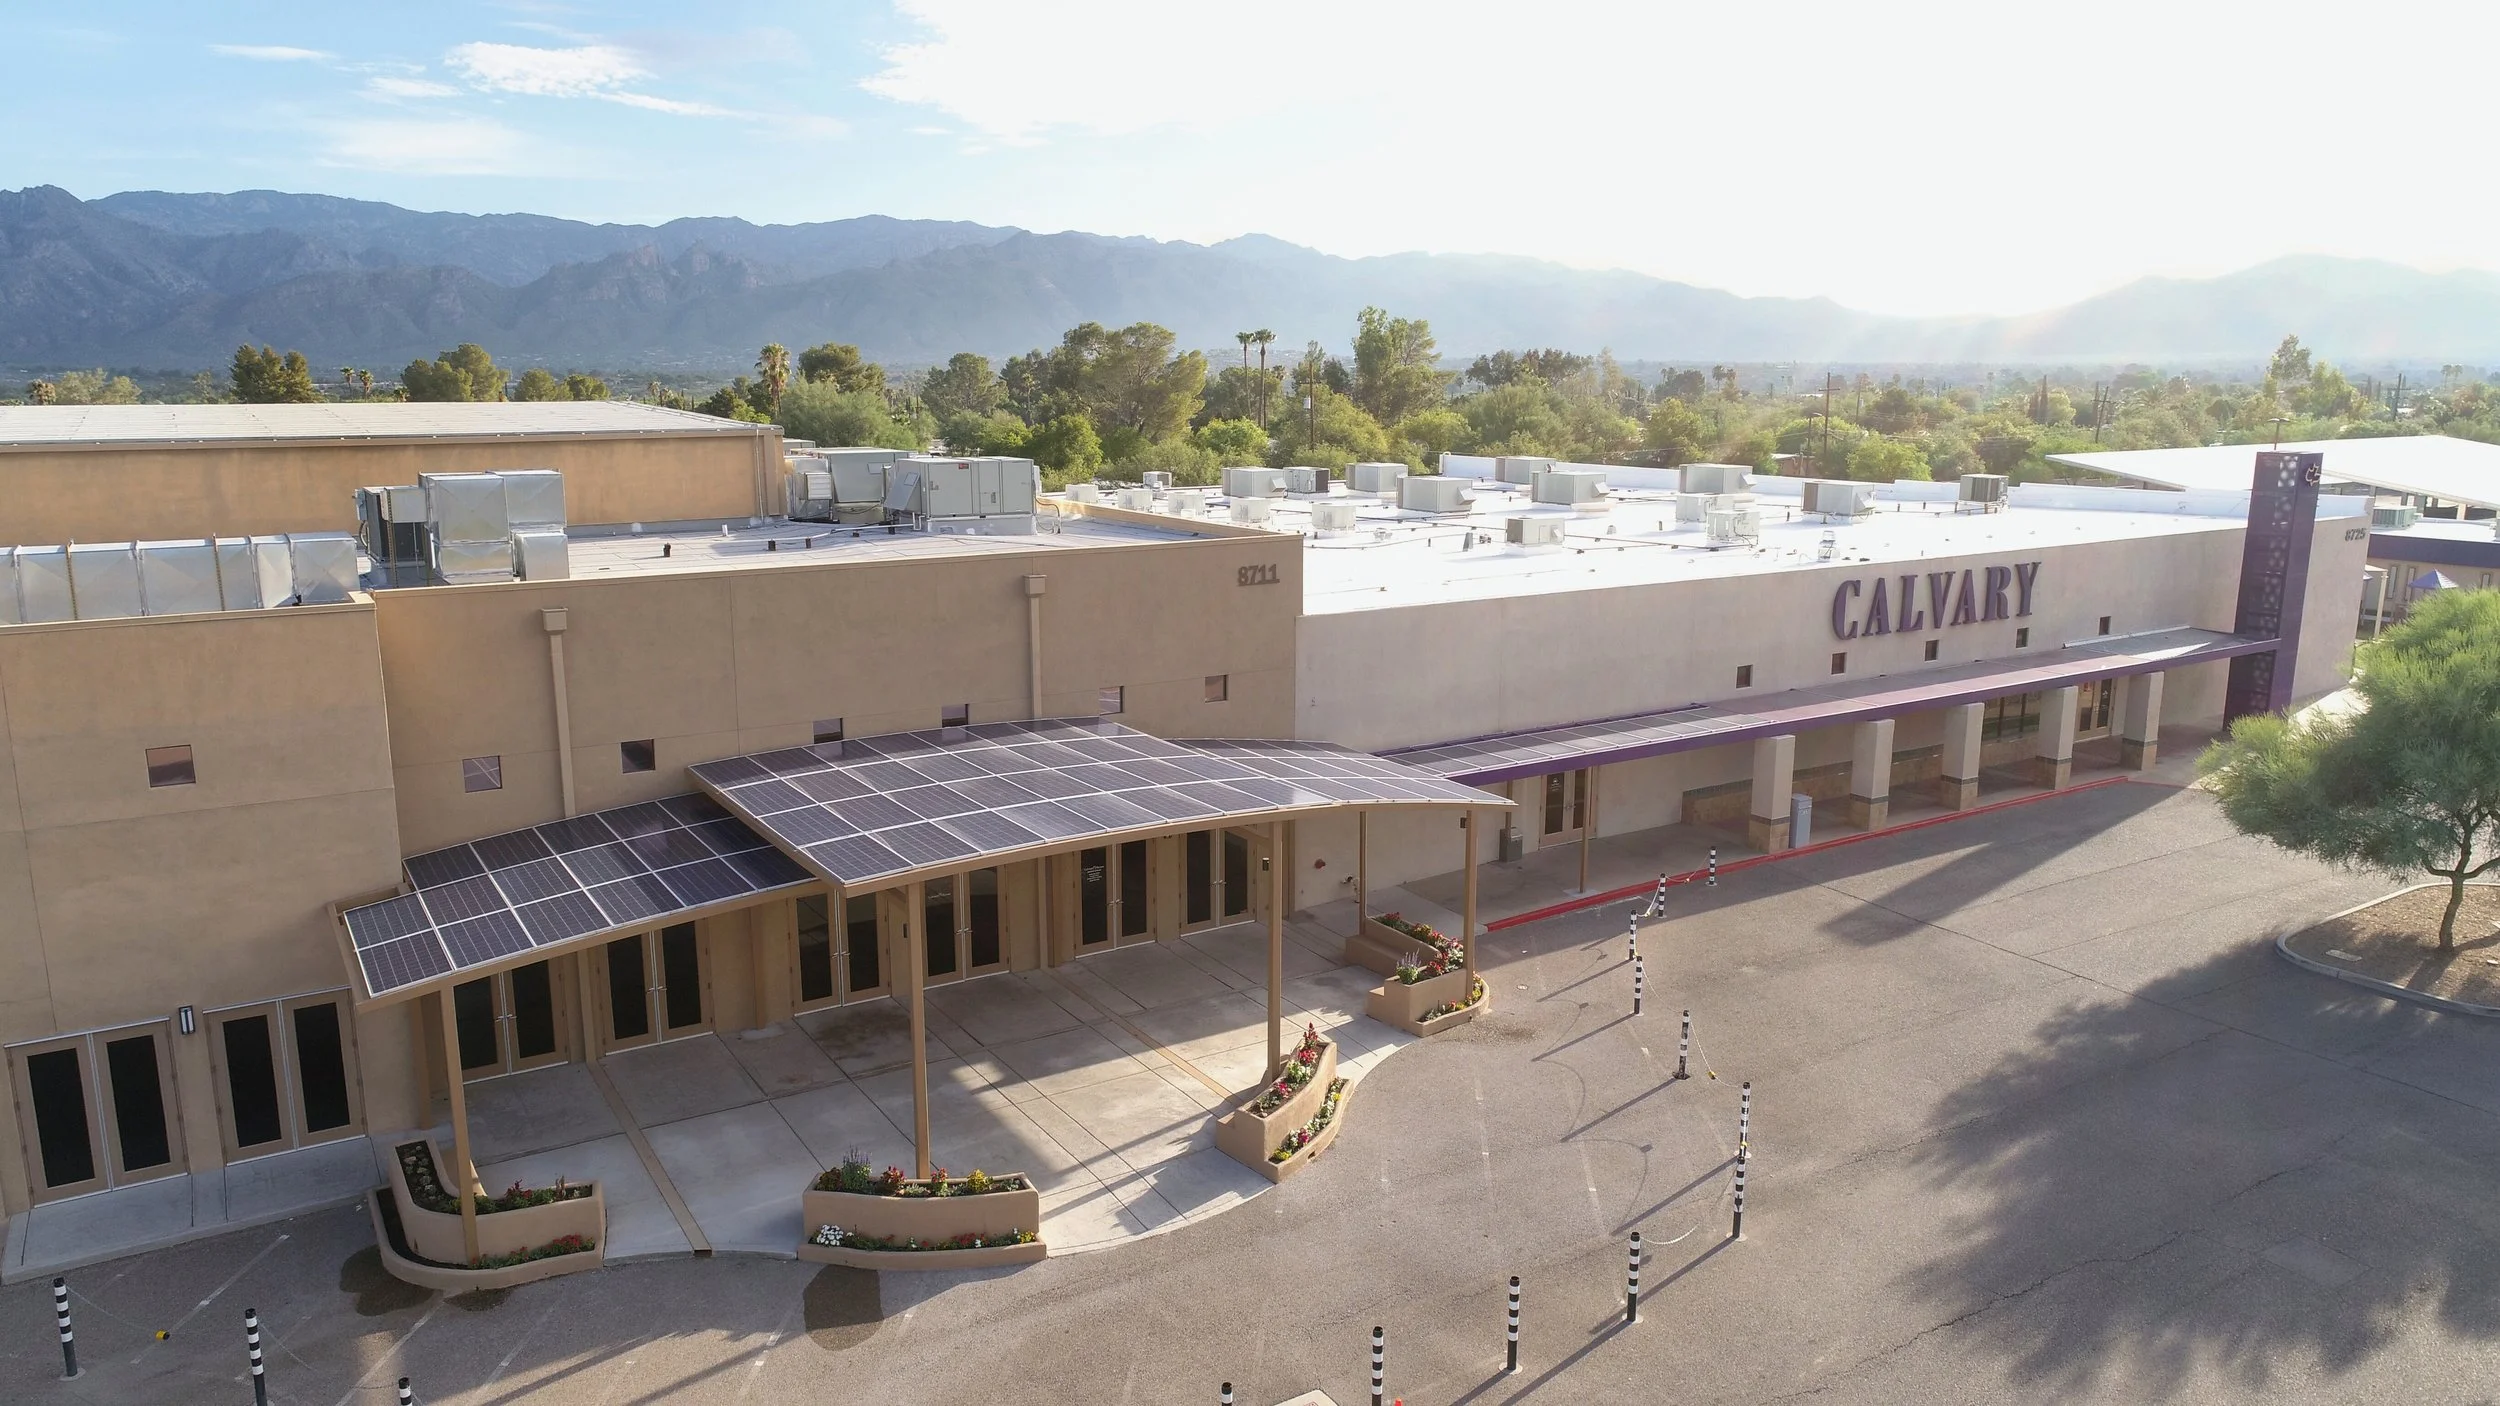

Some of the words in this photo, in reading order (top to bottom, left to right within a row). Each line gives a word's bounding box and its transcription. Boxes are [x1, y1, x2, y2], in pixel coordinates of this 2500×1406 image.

[2344, 527, 2367, 541] 8725
[1238, 563, 1280, 586] 8711
[1832, 561, 2042, 640] CALVARY
